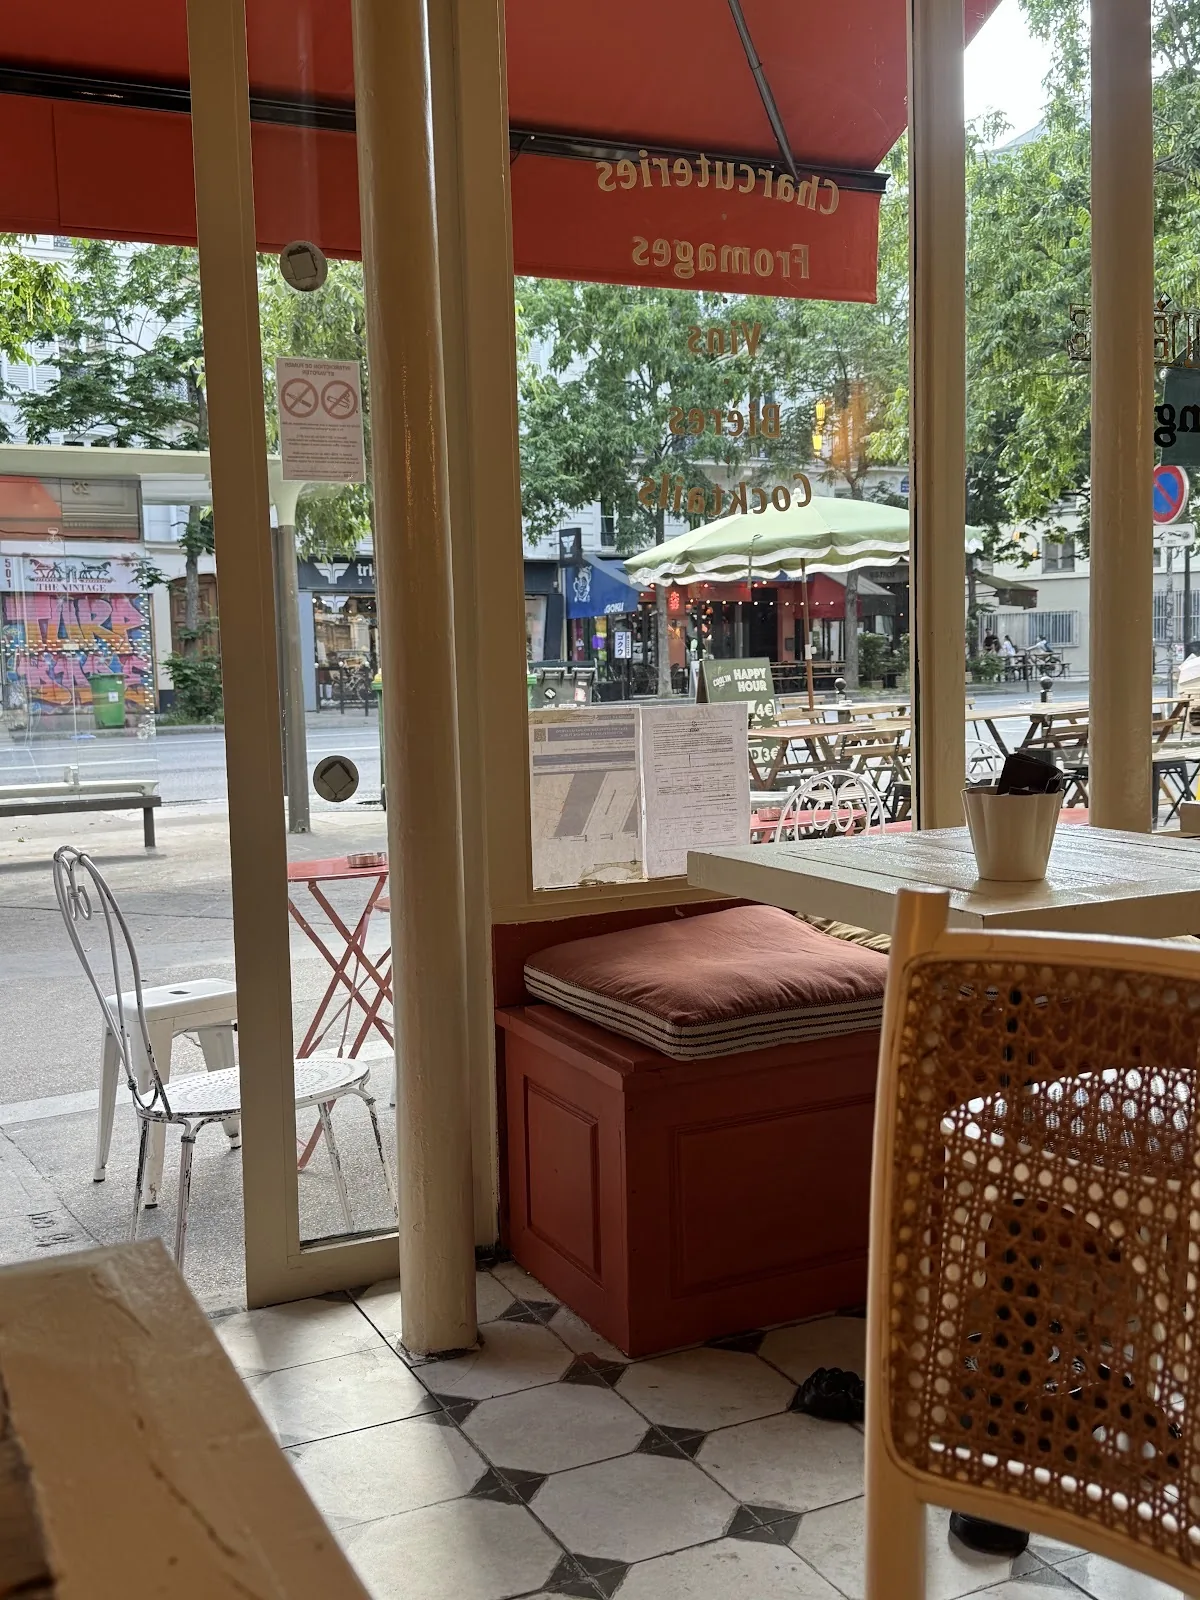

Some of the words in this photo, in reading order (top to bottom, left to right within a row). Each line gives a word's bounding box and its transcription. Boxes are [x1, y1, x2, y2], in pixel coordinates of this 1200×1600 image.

[37, 583, 59, 591] THE
[62, 583, 107, 592] VINTAGE
[733, 668, 766, 680] HAPPY
[737, 680, 767, 692] HOUR
[756, 703, 774, 717] 4€
[762, 747, 779, 761] 3€
